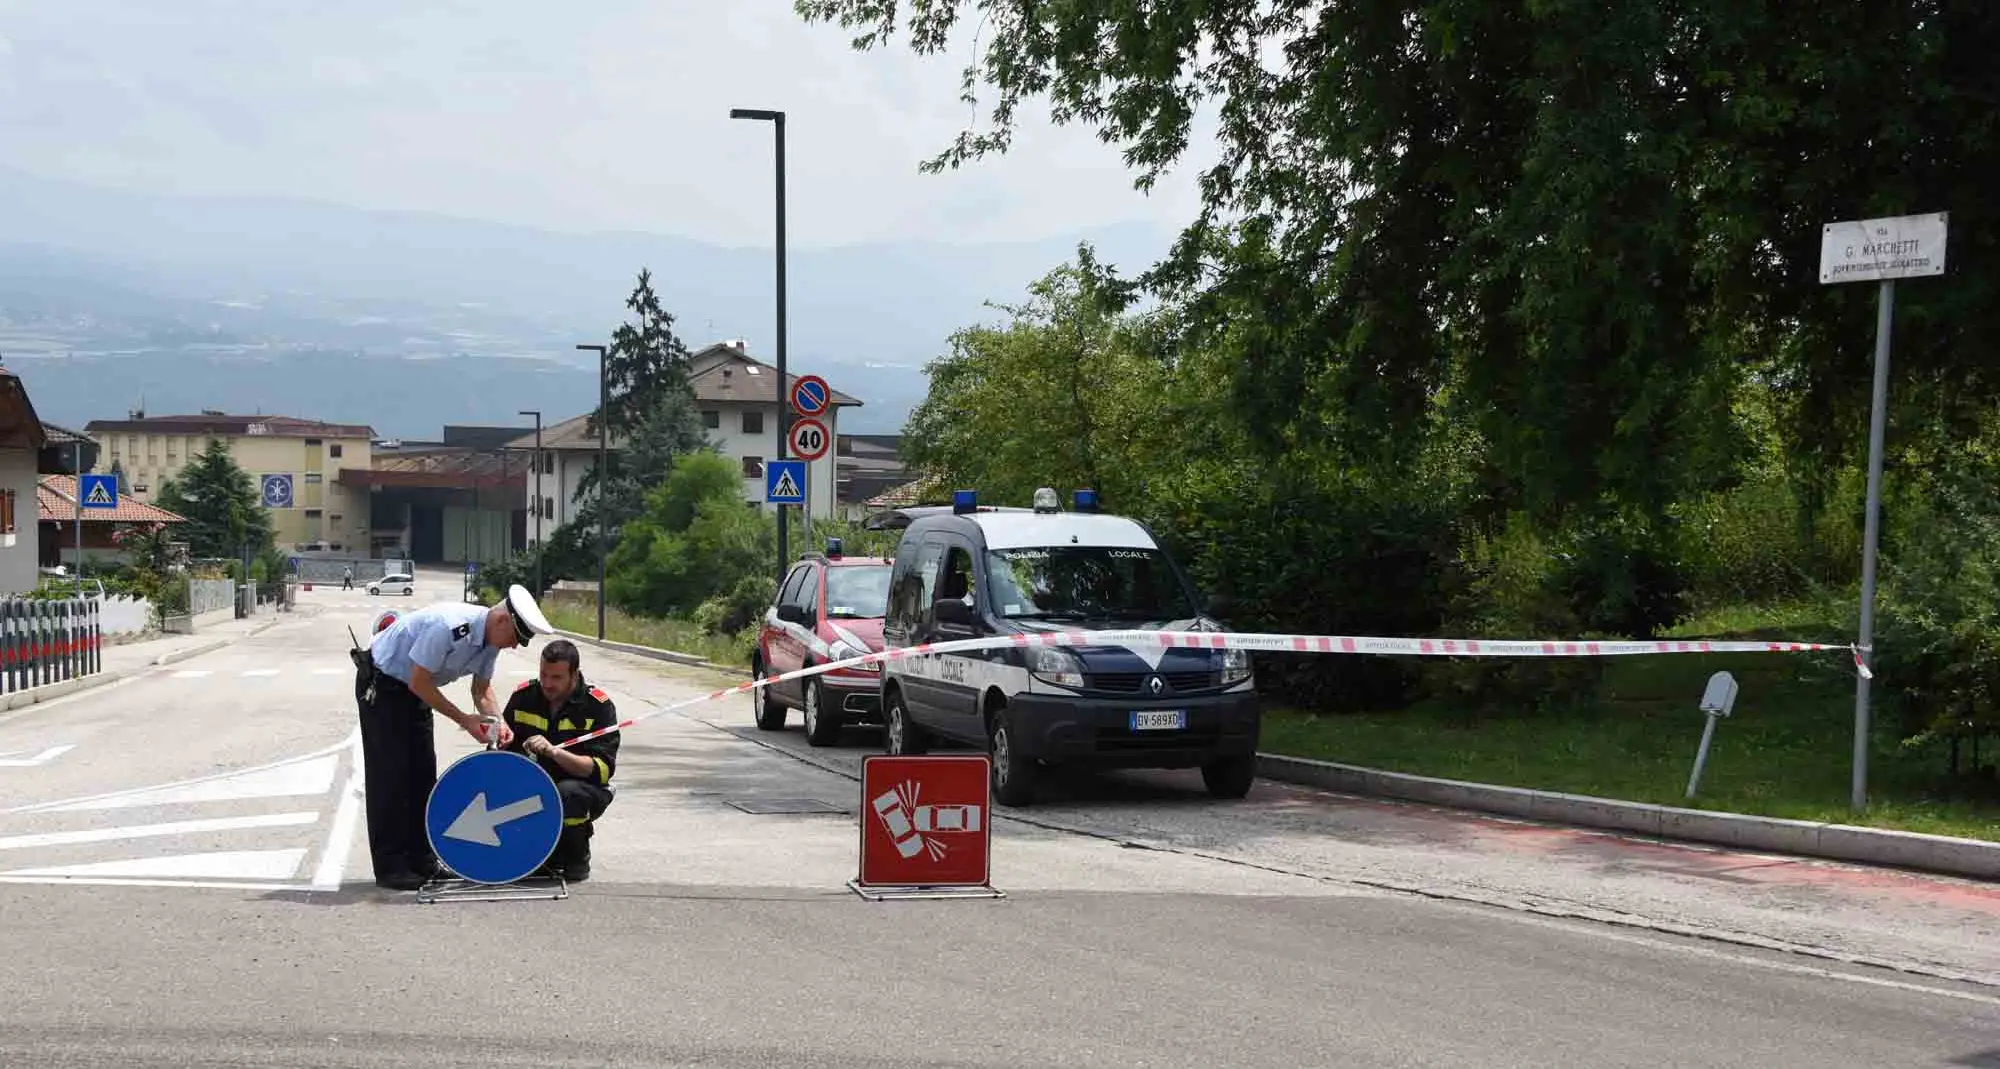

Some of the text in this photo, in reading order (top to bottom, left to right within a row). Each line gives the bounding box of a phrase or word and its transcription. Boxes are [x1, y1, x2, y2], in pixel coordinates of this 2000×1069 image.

[1862, 239, 1919, 257] MARCHETTI
[798, 430, 821, 449] 40
[1005, 550, 1151, 560] POLIZIA LOCALE
[941, 659, 964, 682] LOCALE
